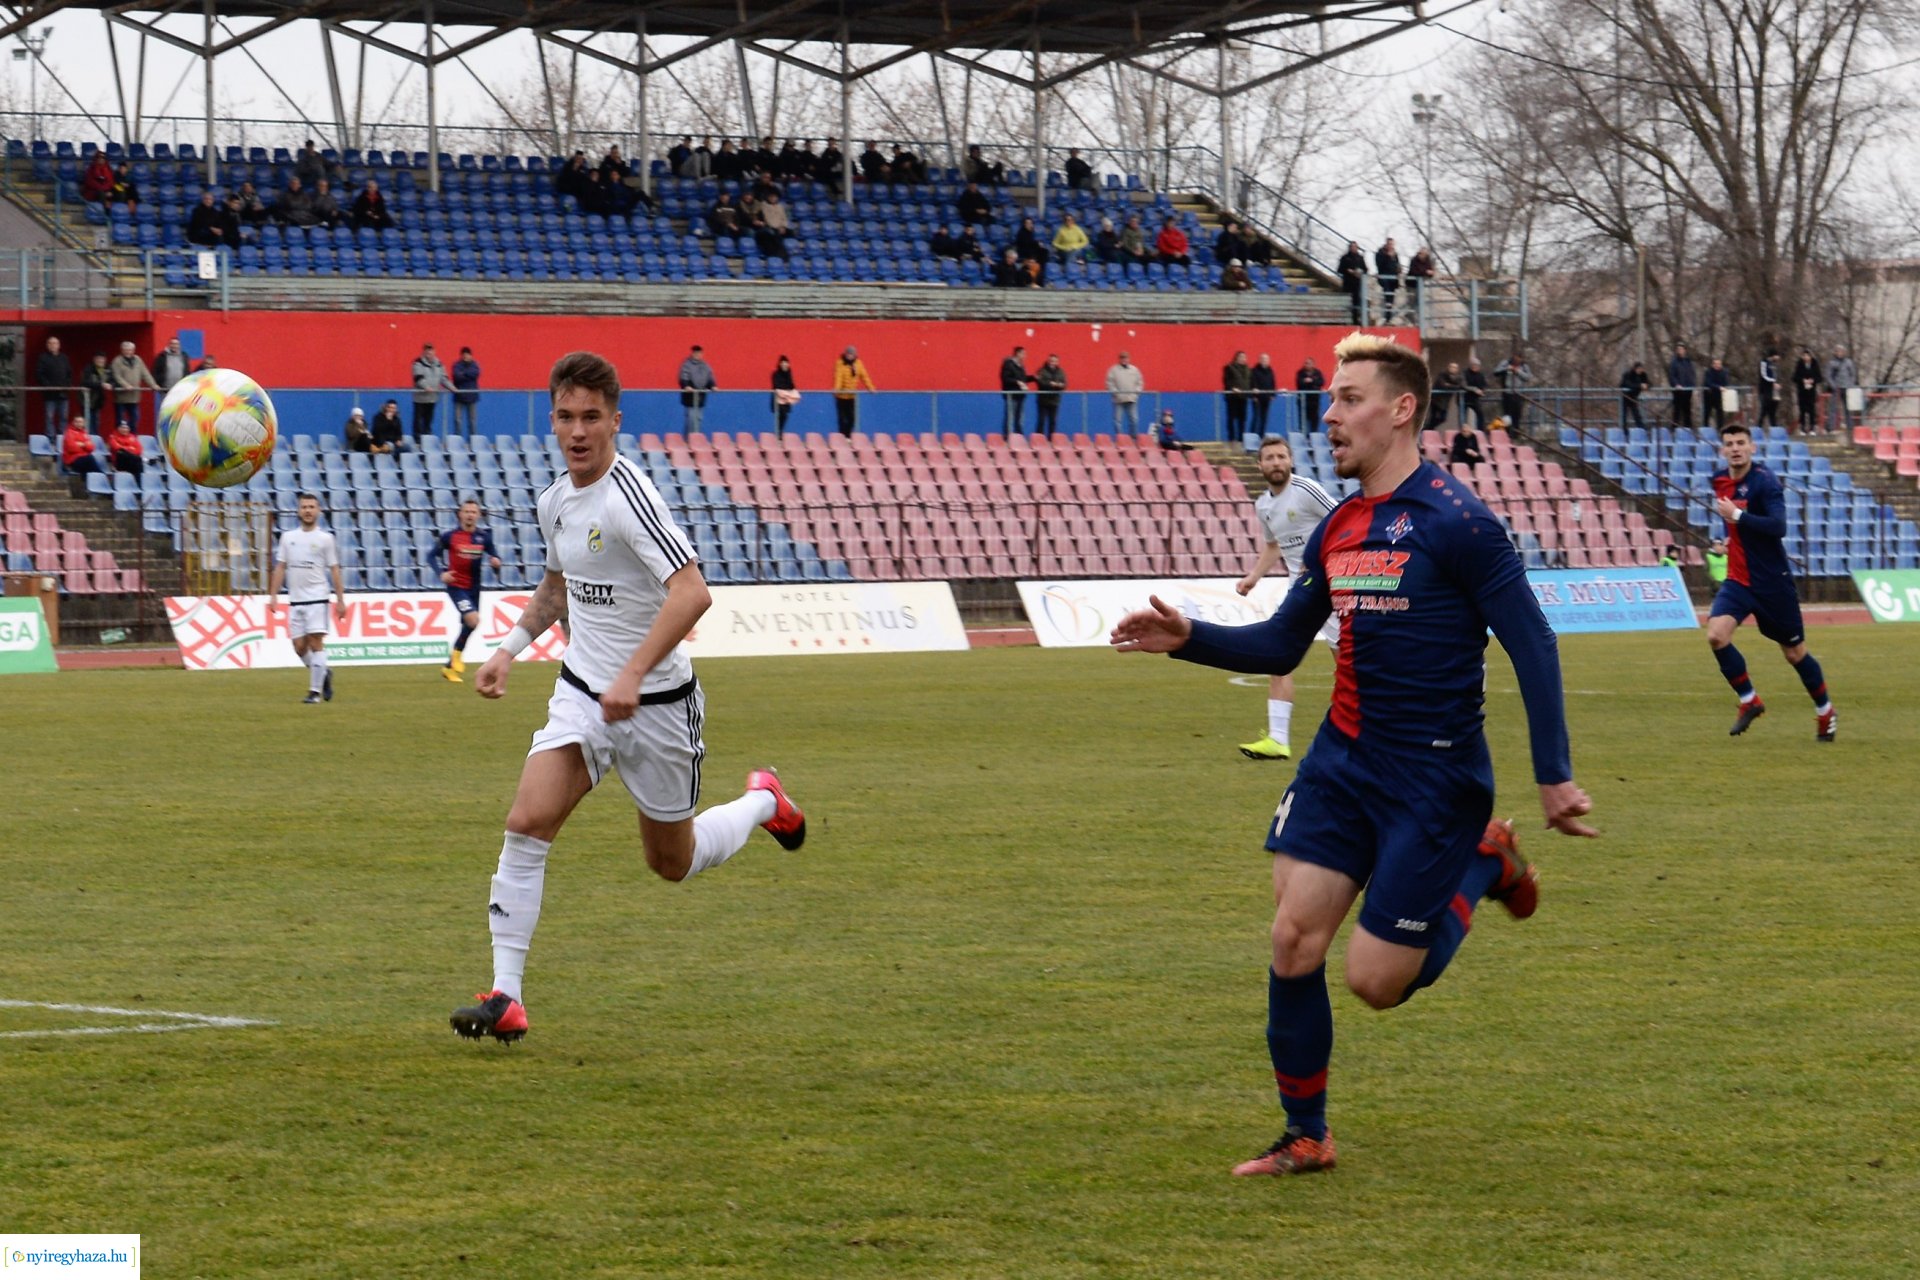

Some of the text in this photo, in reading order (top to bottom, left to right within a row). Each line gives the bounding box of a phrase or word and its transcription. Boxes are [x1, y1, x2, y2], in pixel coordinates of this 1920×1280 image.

[781, 591, 849, 602] HOTEL
[730, 605, 918, 634] AVENTINUS
[1274, 790, 1296, 838] 4
